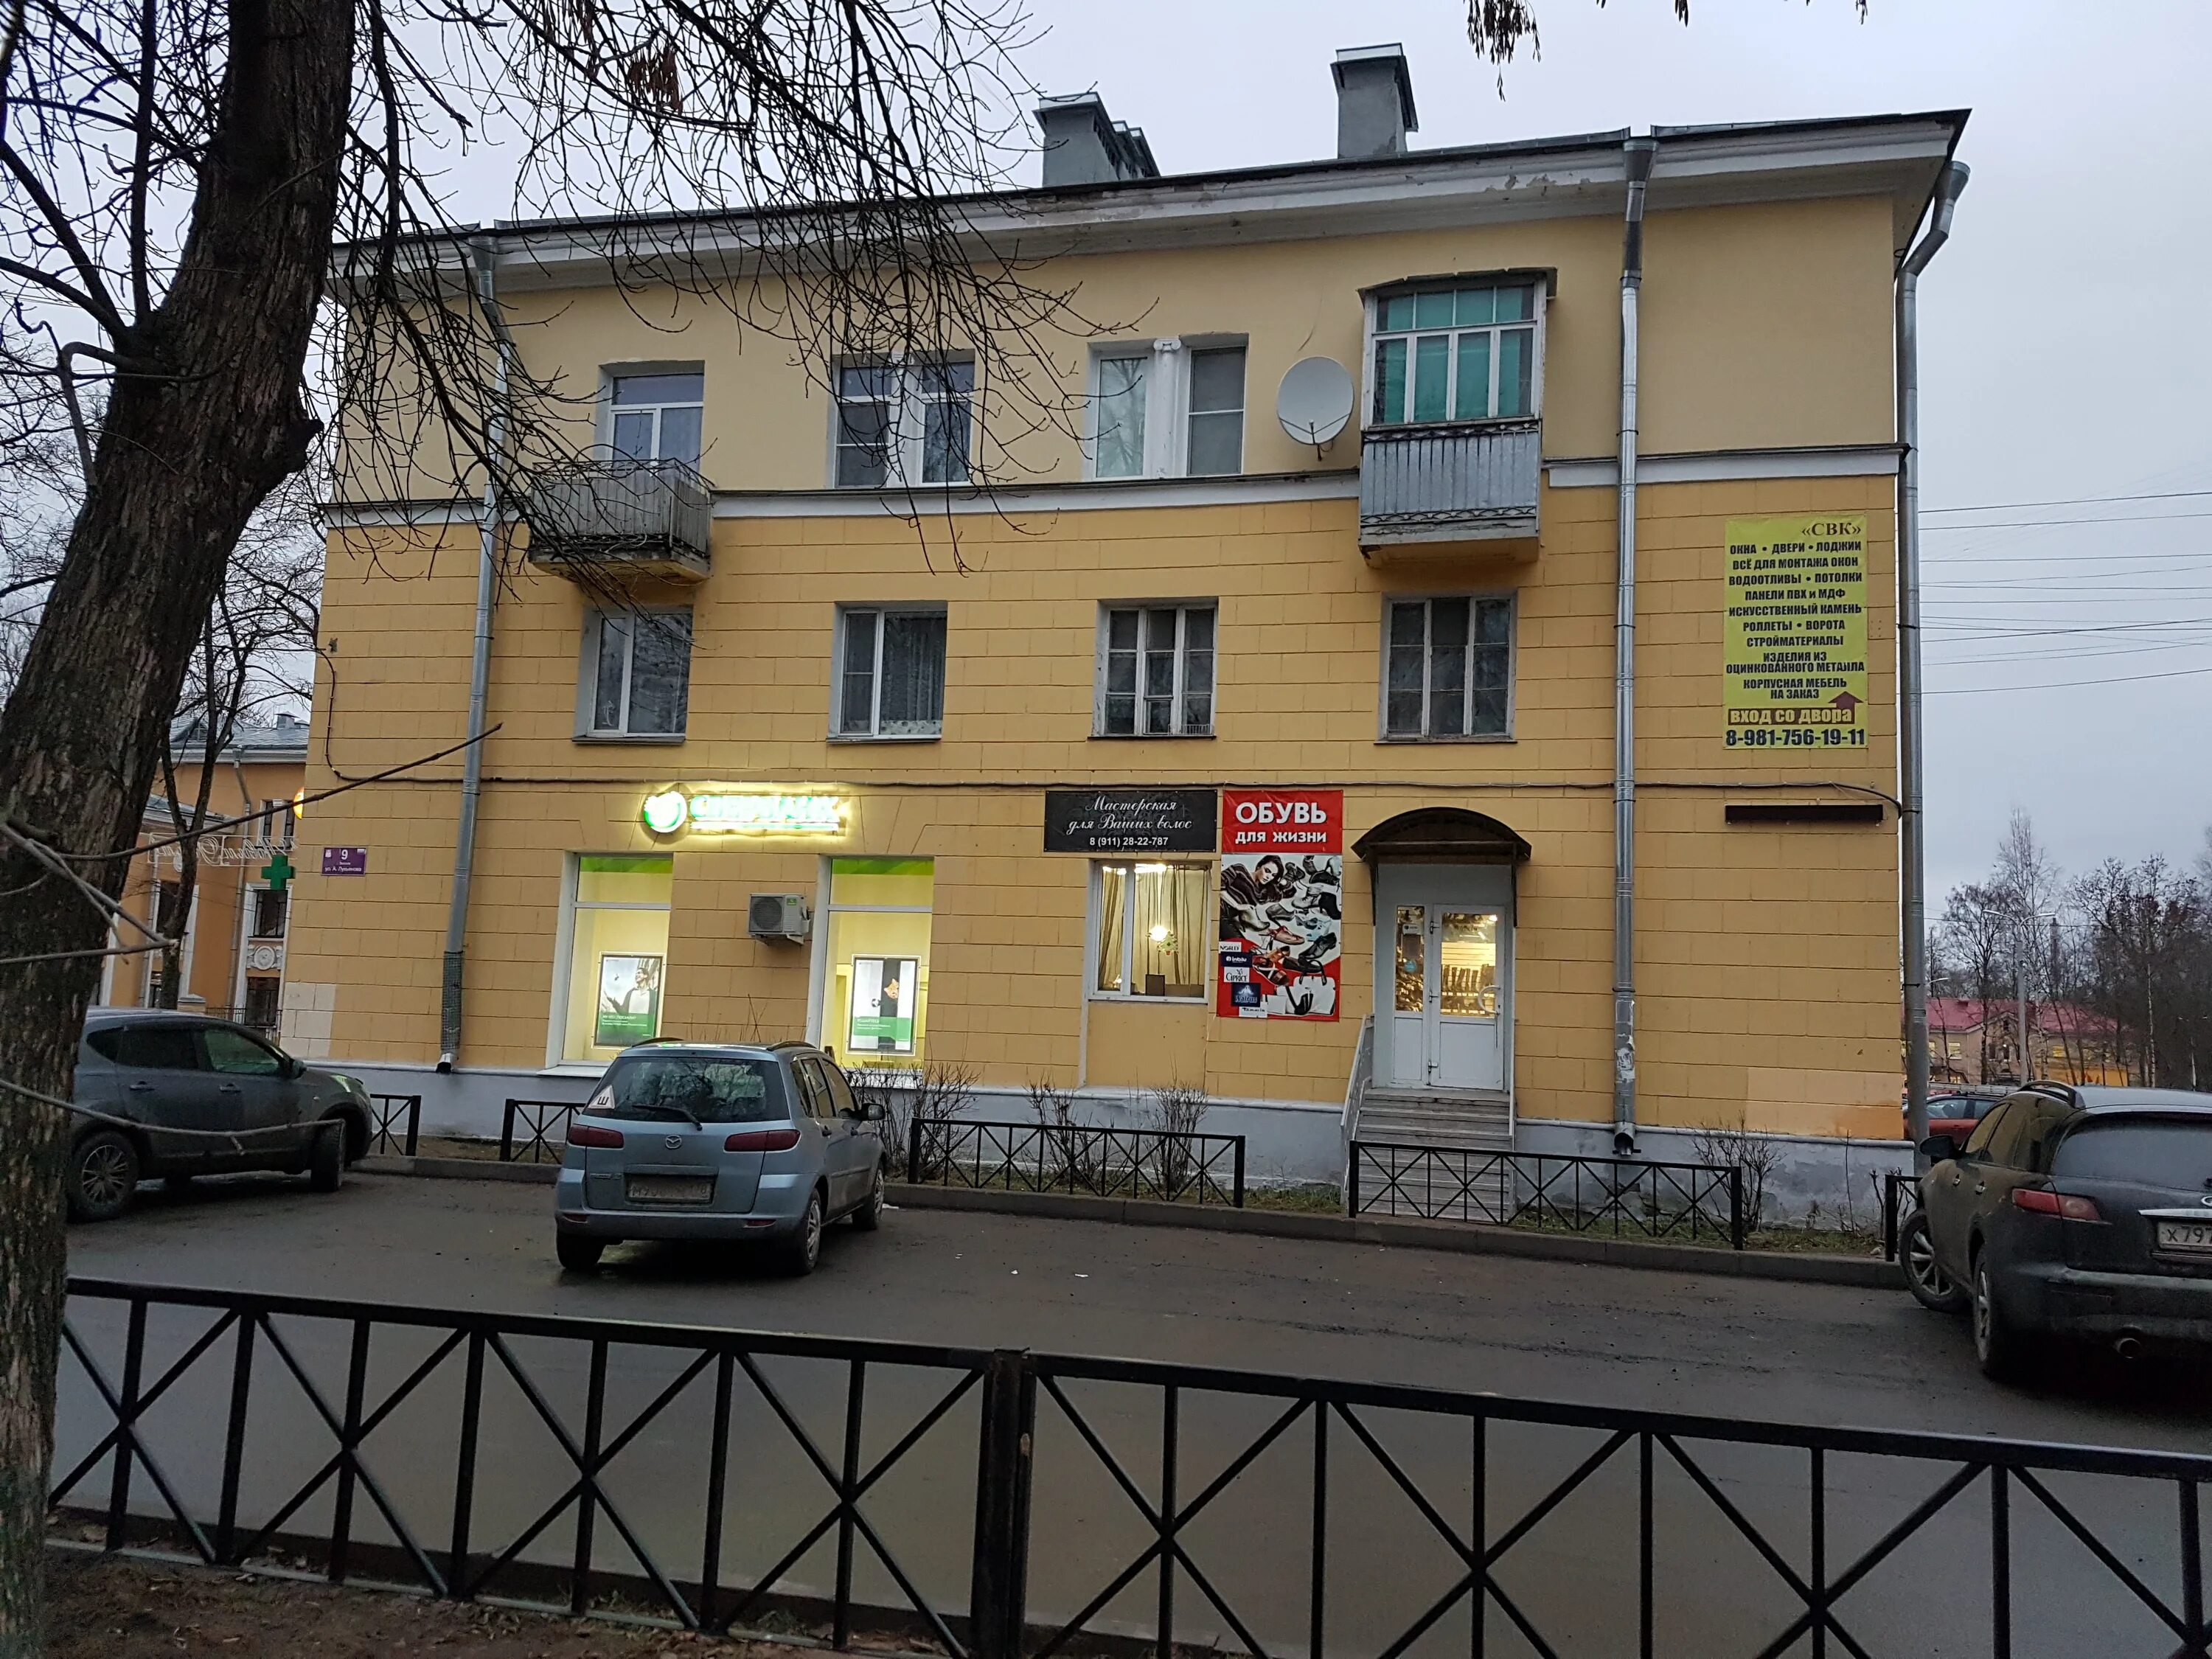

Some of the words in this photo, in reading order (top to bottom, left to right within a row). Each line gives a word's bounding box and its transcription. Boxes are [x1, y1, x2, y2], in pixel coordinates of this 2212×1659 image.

[1731, 545, 1756, 554] ОКНА
[1772, 543, 1805, 554] ДВЕРИ
[1816, 541, 1861, 552] ЛОДЖИИ
[1733, 559, 1752, 570] ВСЁ
[1753, 560, 1775, 571] ДЛЯ
[1778, 558, 1829, 568] МОНТАЖА
[1831, 557, 1858, 566] ОКОН
[1729, 574, 1801, 586] ВОДООТЛИВЫ
[1815, 573, 1862, 582] ПОТОЛКИ
[1745, 591, 1784, 600] ПАНЕЛИ
[1787, 590, 1806, 599] ПВХ
[1818, 588, 1846, 599] МДФ
[1729, 603, 1818, 616] ИСКУССТВЕННЫЙ
[1820, 604, 1862, 614] КАМЕНЬ
[1743, 621, 1792, 631] РОЛЛЕТЫ
[1806, 620, 1845, 630] ВОРОТА
[1747, 636, 1843, 647] СТРОЙМАТЕРИАЛЫ
[1764, 652, 1811, 663] ИЗДЕЛИЯ
[1813, 652, 1826, 661] ИЗ
[1726, 664, 1814, 675] ОЦИНКОВАННОГО
[1816, 662, 1864, 672] МЕТАЛЛА
[1743, 678, 1804, 689] КОРПУСНАЯ
[1806, 678, 1846, 687] МЕБЕЛЬ
[1770, 690, 1784, 699] НА
[1787, 689, 1819, 699] ЗАКАЗ
[1726, 728, 1865, 745] 8-981-756-19-11
[1085, 796, 1177, 816] Мастерская
[1236, 802, 1326, 824] ОБУВЬ
[1066, 820, 1094, 835] для
[1098, 813, 1152, 830] Ваших
[1157, 815, 1192, 829] волос
[1090, 838, 1095, 846] 8
[1098, 837, 1120, 847] (911)
[1123, 838, 1168, 846] 28-22-787
[341, 849, 348, 860] 9
